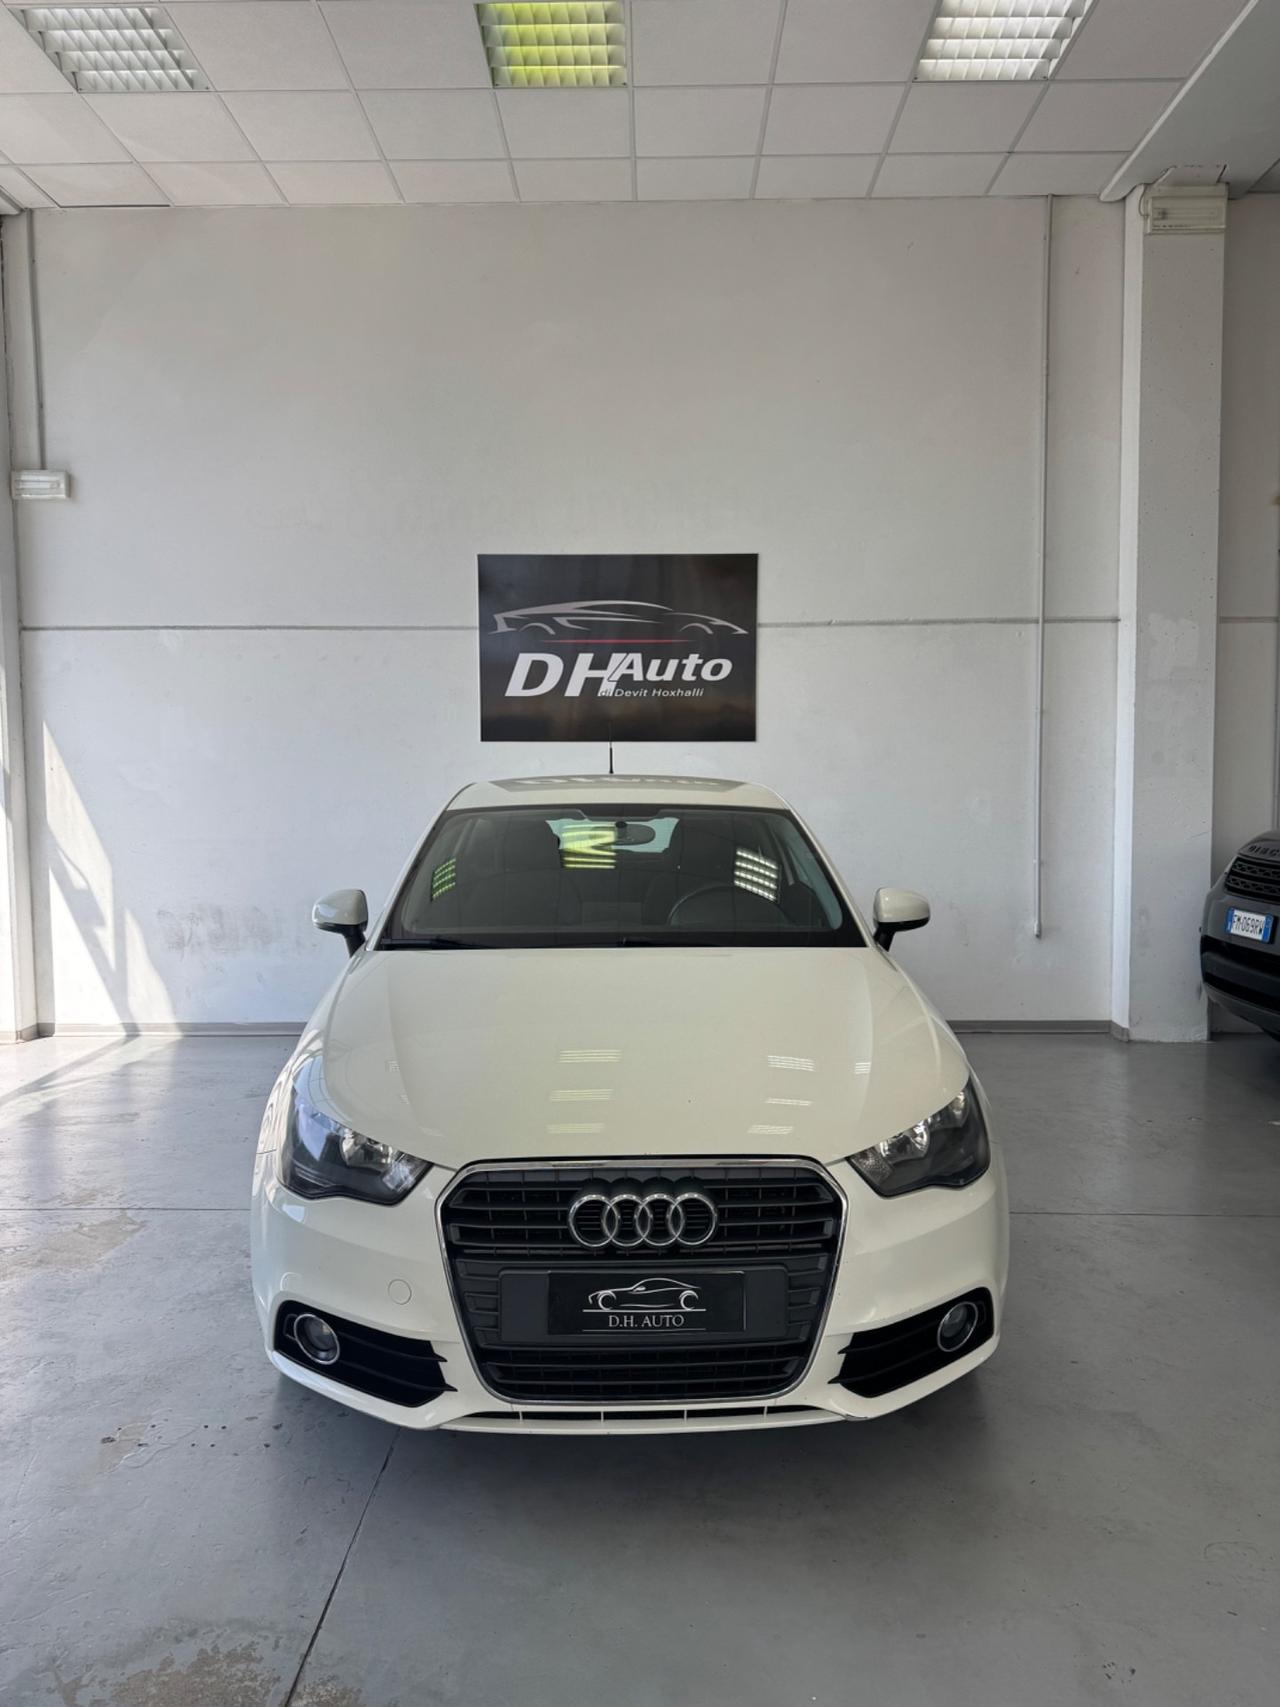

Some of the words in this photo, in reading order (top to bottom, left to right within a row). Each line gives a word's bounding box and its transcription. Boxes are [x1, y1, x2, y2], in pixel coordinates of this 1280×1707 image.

[614, 688, 648, 697] Devit
[651, 687, 704, 697] Hoxhalli
[608, 1315, 638, 1328] D.H.
[641, 1314, 685, 1328] AUTO
